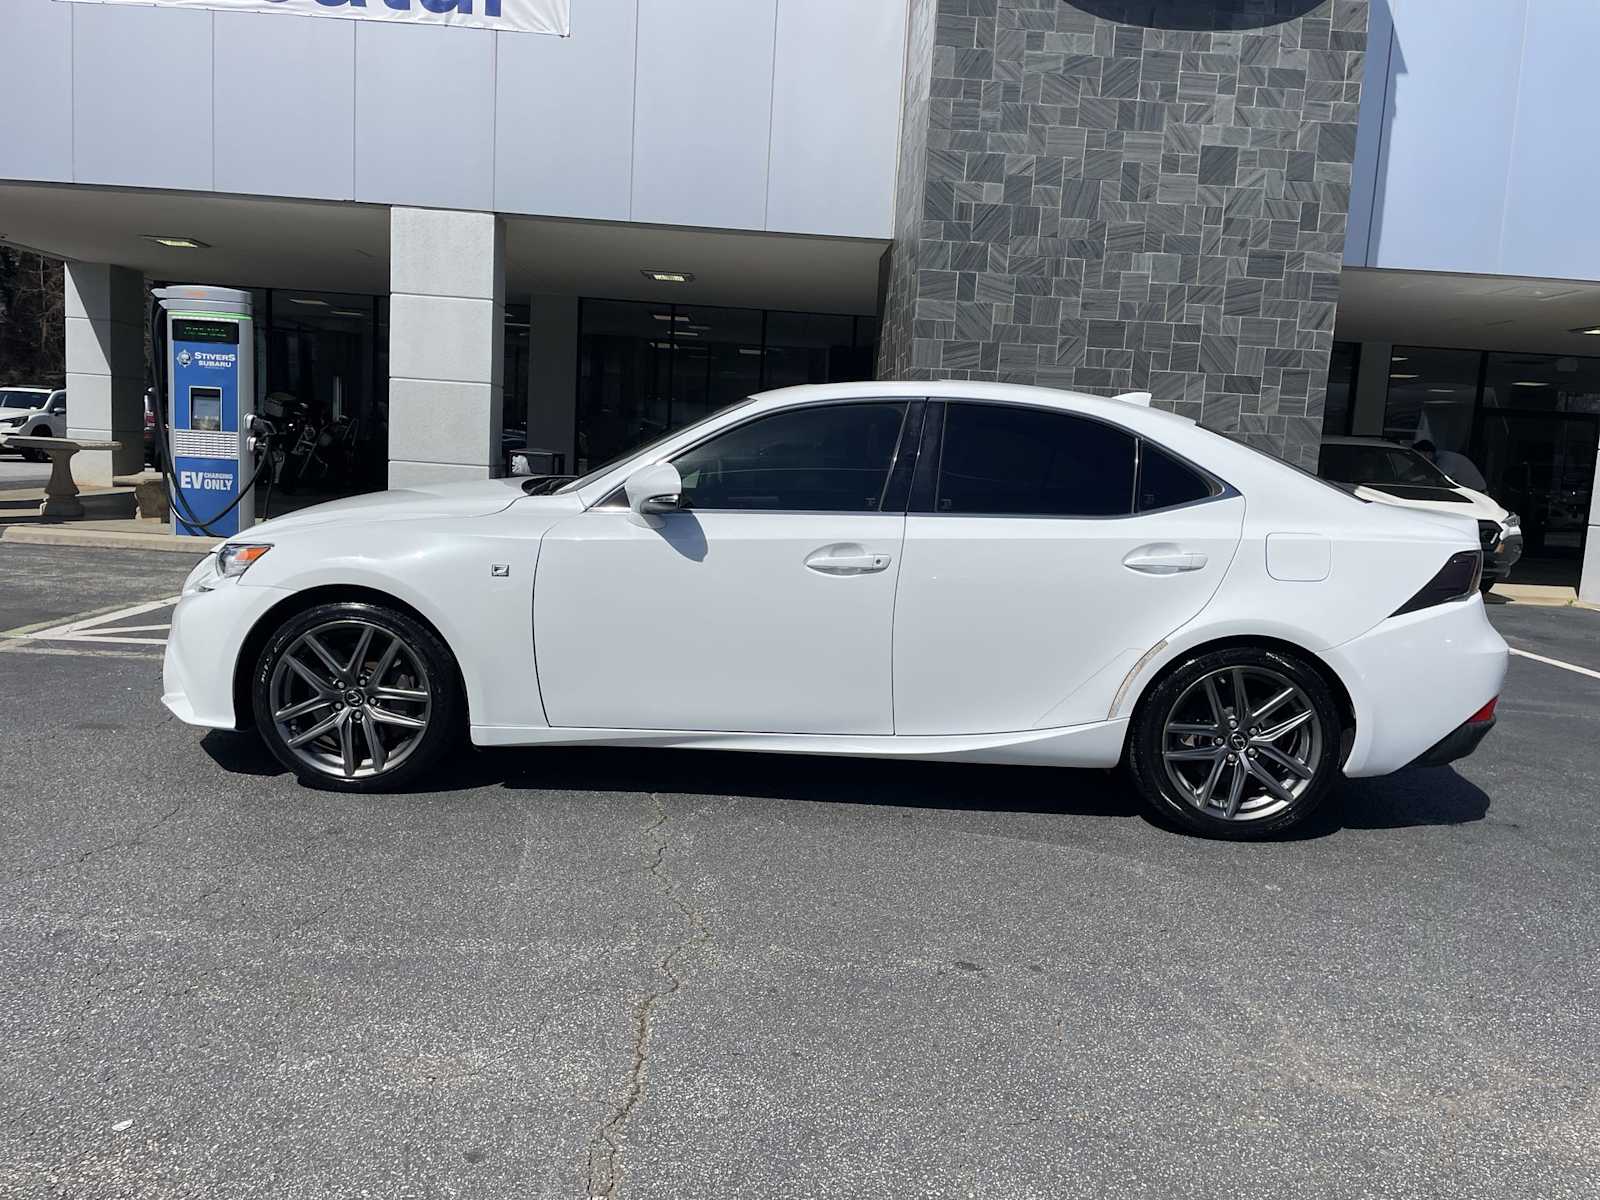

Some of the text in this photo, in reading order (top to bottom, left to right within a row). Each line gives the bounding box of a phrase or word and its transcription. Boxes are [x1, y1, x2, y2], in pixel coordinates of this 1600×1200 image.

[194, 351, 236, 362] STIVERS
[198, 360, 232, 368] SUBARU
[180, 470, 204, 489] EV
[203, 472, 234, 480] CHARGING
[203, 479, 233, 491] ONLY
